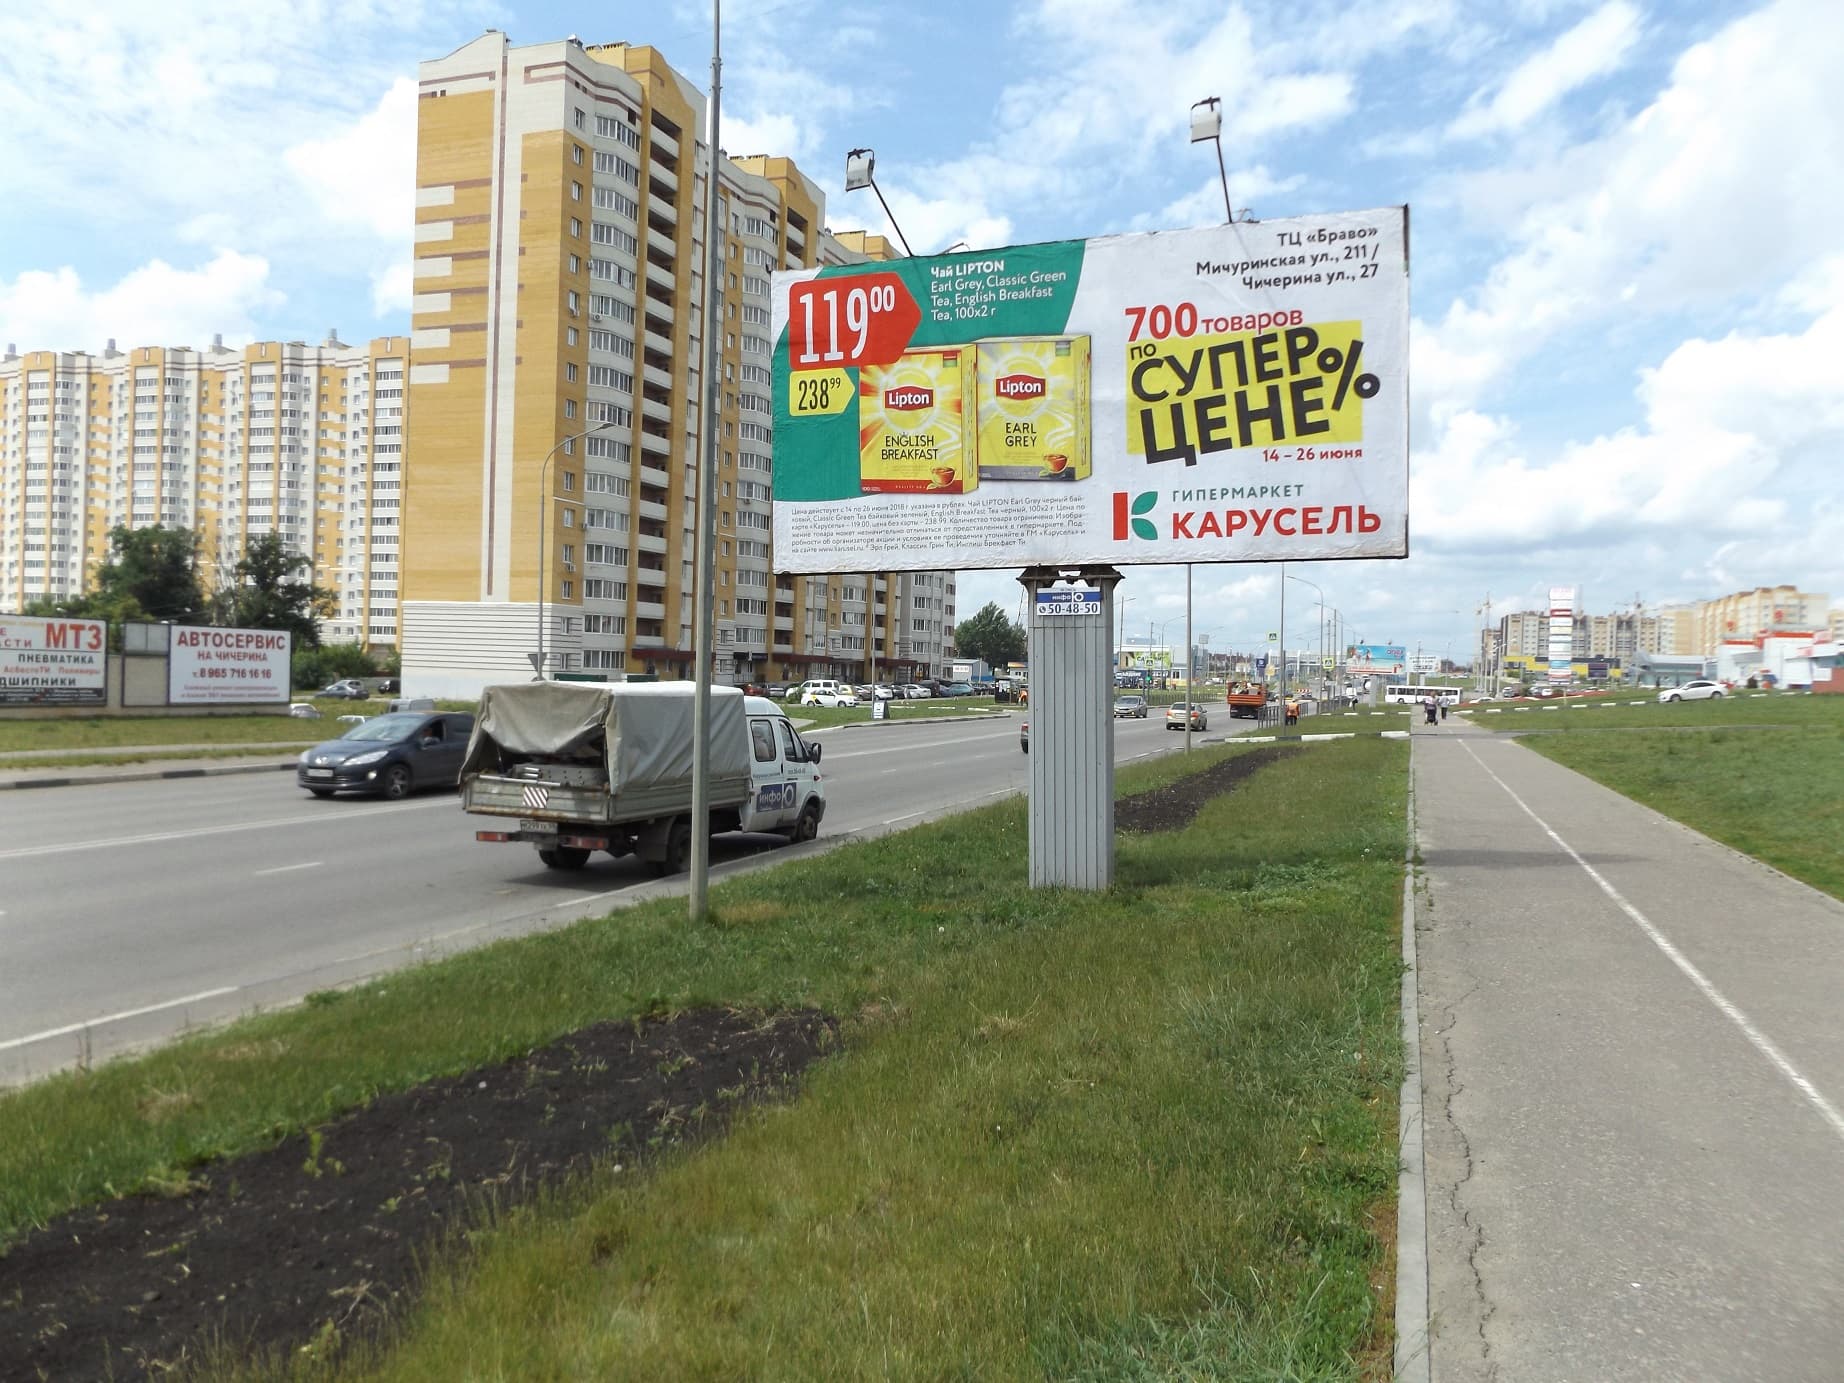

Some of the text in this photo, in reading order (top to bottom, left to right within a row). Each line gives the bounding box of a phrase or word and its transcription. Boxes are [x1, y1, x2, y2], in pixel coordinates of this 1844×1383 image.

[1277, 227, 1378, 247] ТЦ «Браво»
[1196, 243, 1380, 276] Мичуринская ул., 211 /
[931, 260, 1005, 278] Чай LIPTON
[1242, 263, 1379, 290] Чичерина ул., 27
[931, 271, 1067, 293] Earl Grey, Classic Green
[931, 287, 1053, 307] Tea, English Breakfast
[931, 309, 953, 321] Tea,
[1124, 302, 1304, 342] 700 товаров
[1131, 326, 1320, 403] СУПЕР
[999, 381, 1042, 396] Lipton
[888, 391, 930, 407] Lipton
[1005, 422, 1037, 434] EARL
[1139, 375, 1331, 468] ЦЕНЕ
[885, 434, 935, 447] ENGLISH
[1005, 435, 1037, 448] GREY
[881, 449, 939, 460] BREAKFAST
[1262, 449, 1279, 462] 14
[1296, 448, 1316, 461] 26
[1319, 448, 1363, 460] июня
[1172, 484, 1304, 502] ГИПЕРМАРКЕТ
[982, 498, 1009, 506] LIPTON
[1172, 505, 1382, 540] КАРУСЕЛЬ
[1047, 602, 1098, 614] 50-48-50
[45, 622, 102, 650] МТЗ
[177, 630, 286, 650] АВТОСЕРВИС
[18, 653, 94, 664] ПНЕВМАТИКА
[197, 651, 268, 662] НА ЧИЧЕРИНА
[208, 668, 227, 679] 965
[230, 668, 247, 679] 716
[249, 668, 259, 679] 16
[261, 668, 272, 679] 16
[760, 790, 781, 804] инфо
